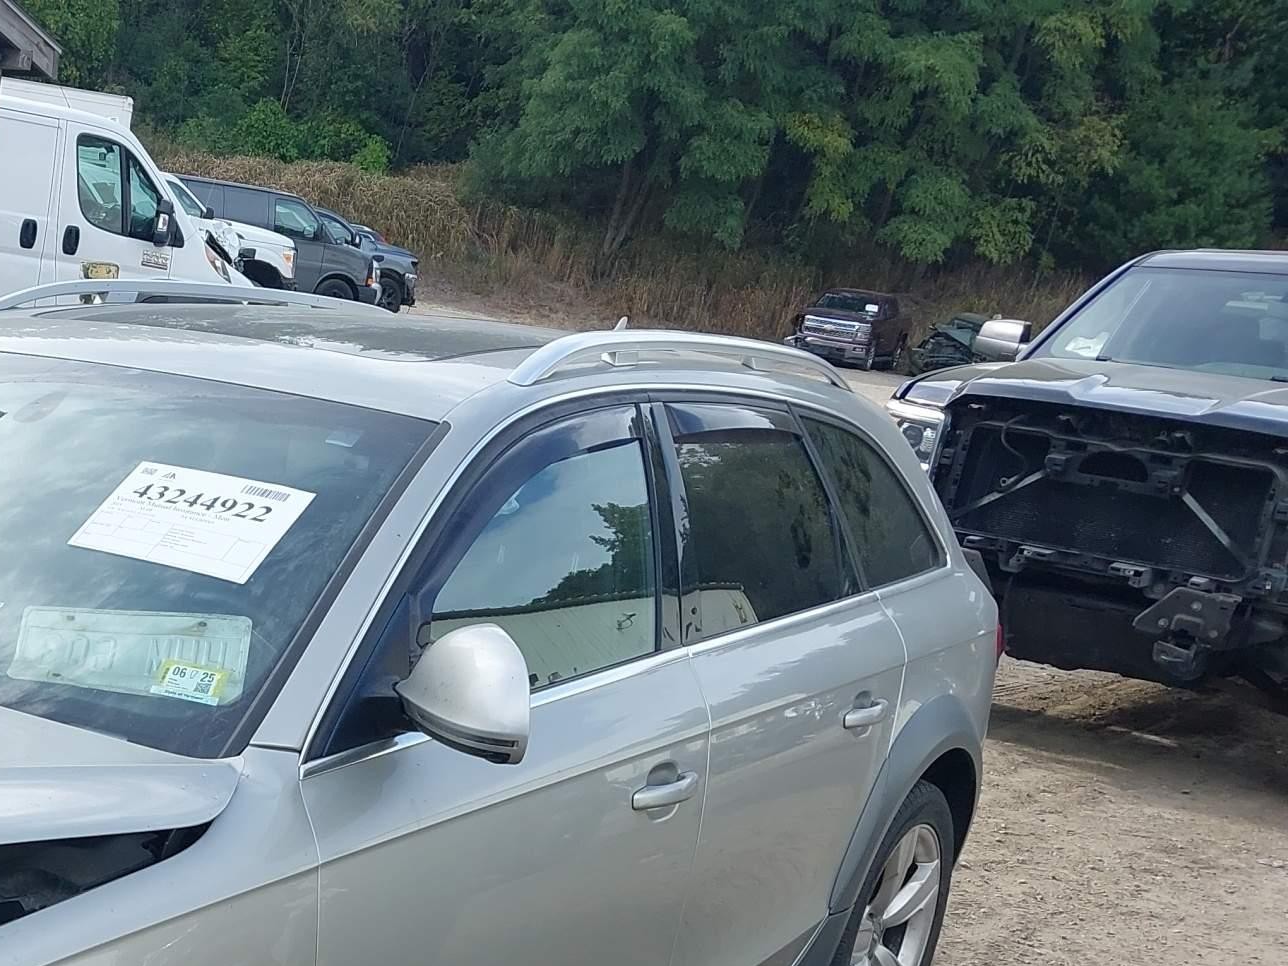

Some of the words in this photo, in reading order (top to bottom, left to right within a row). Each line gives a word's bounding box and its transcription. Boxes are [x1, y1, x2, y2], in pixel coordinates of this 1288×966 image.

[133, 483, 273, 523] 43244922
[172, 666, 188, 678] 06
[199, 672, 217, 683] 25
